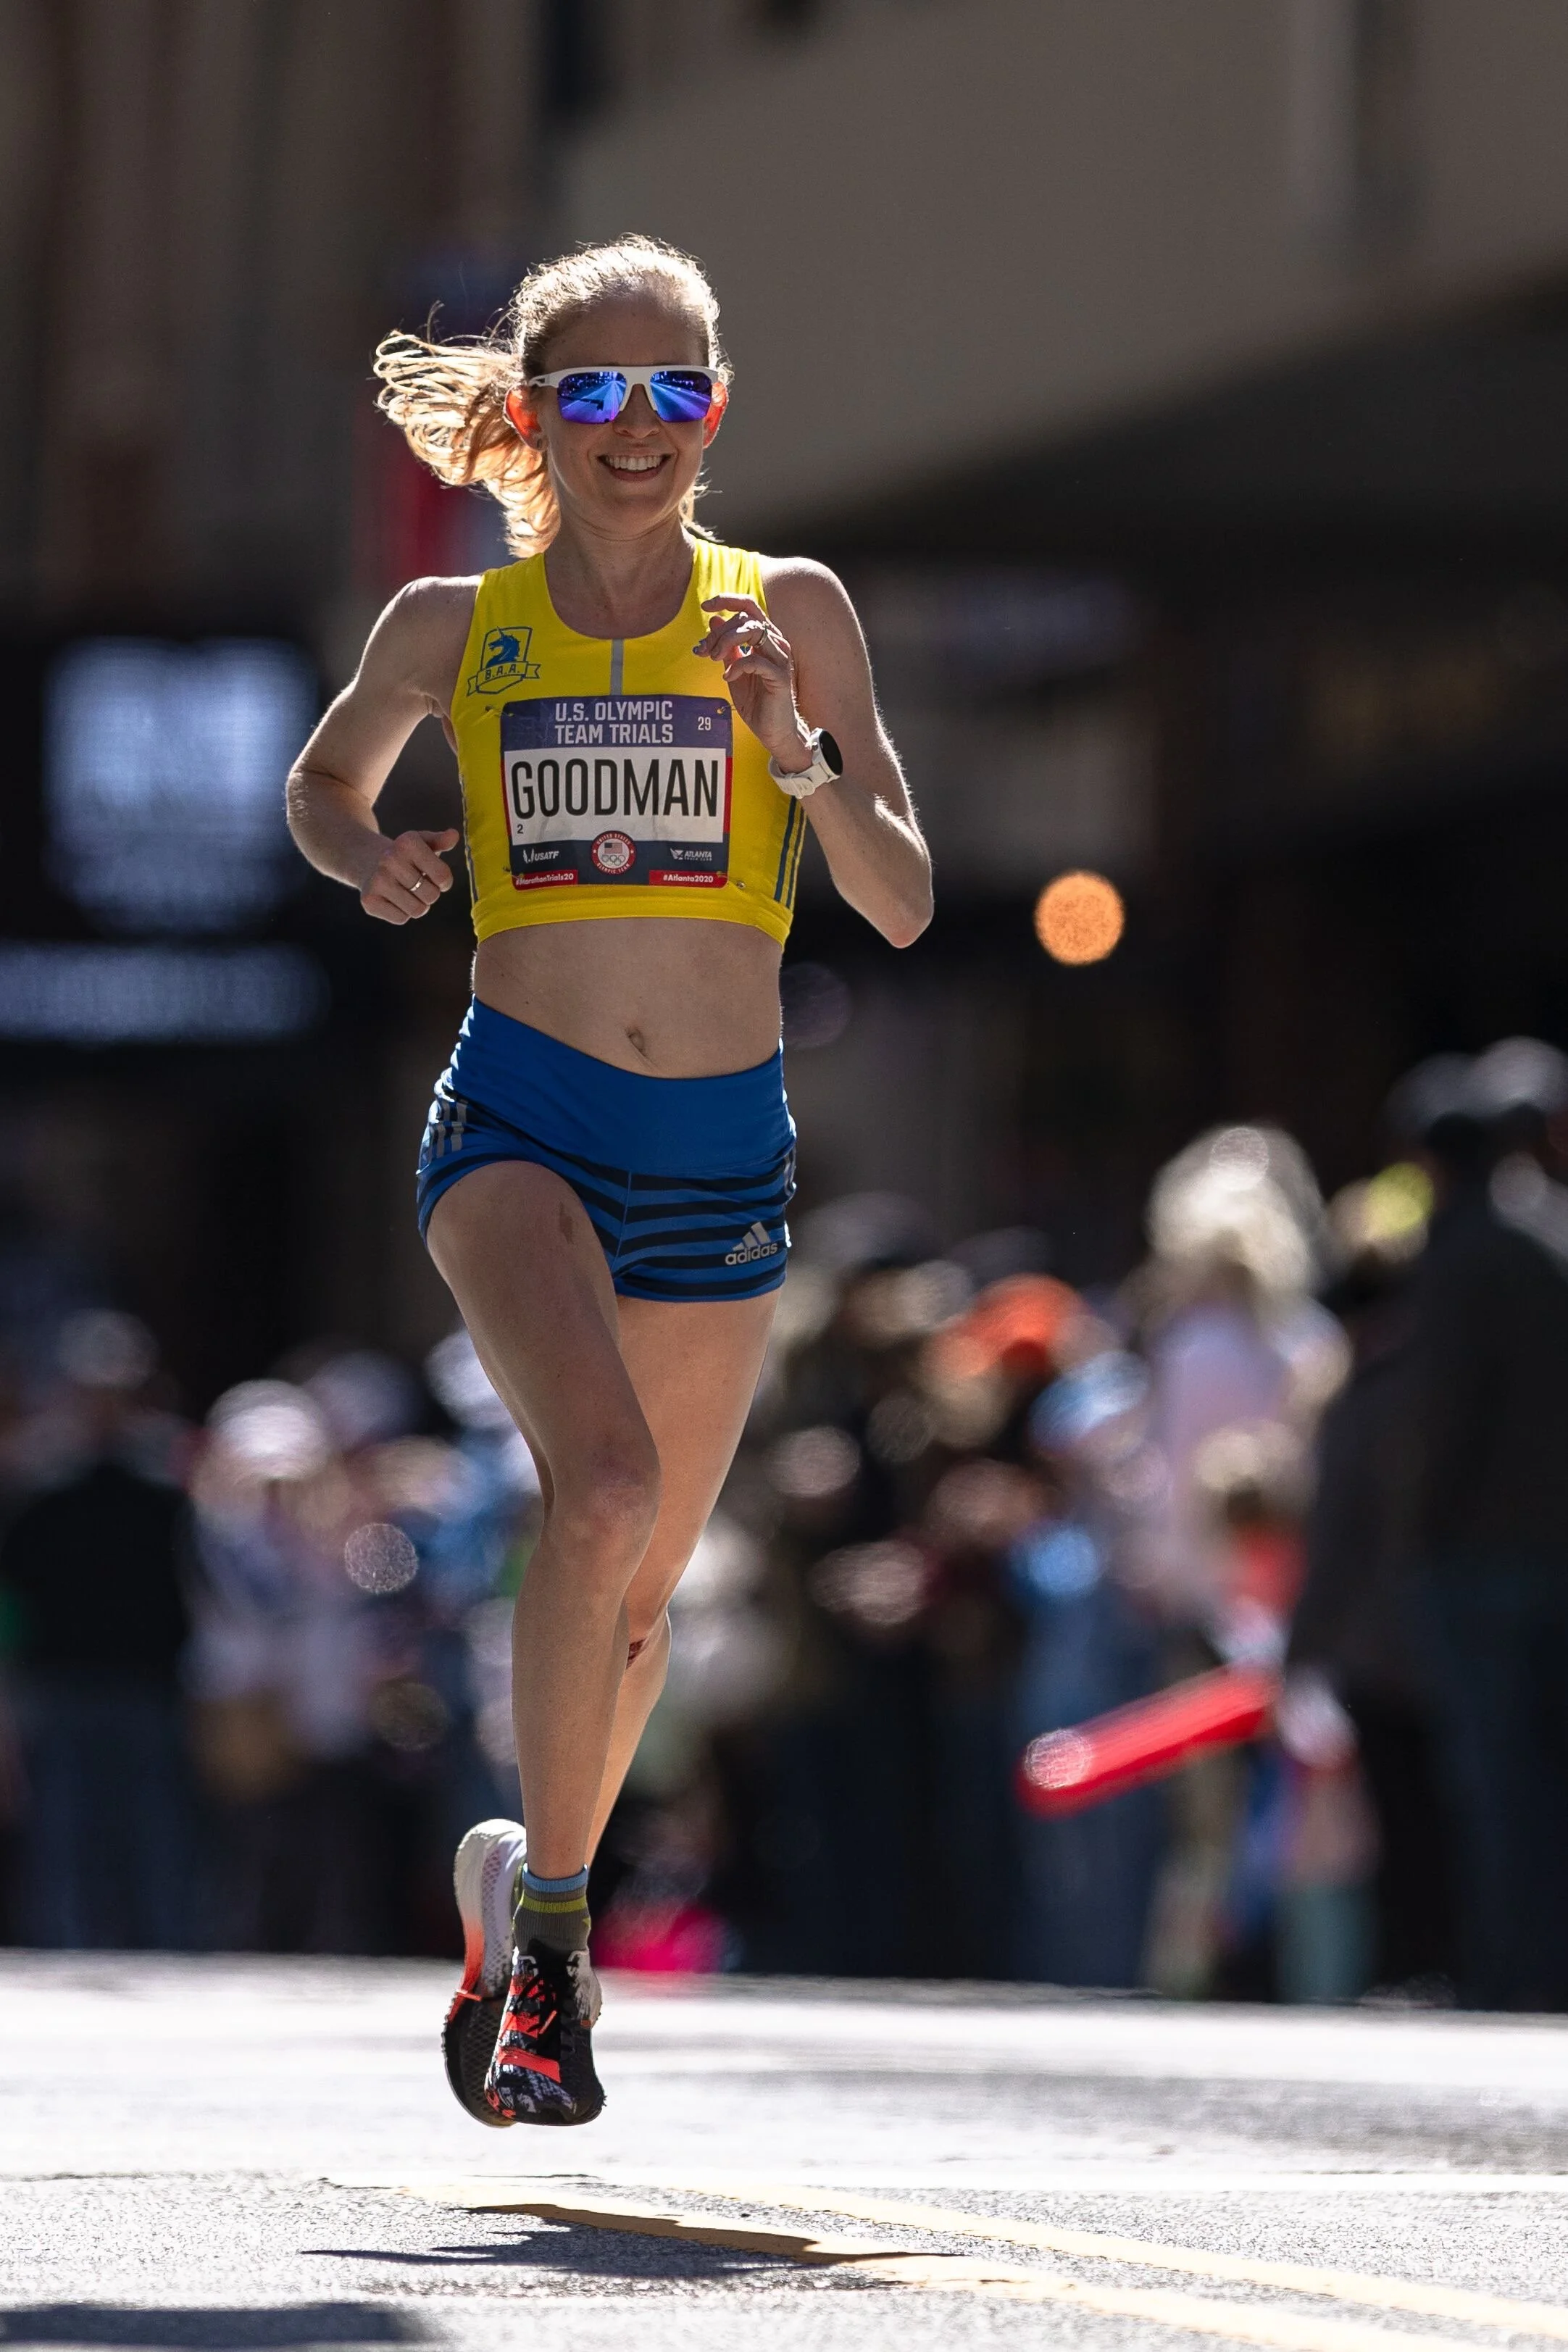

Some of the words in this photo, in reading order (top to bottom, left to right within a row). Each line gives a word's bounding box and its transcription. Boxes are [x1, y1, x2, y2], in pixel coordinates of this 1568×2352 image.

[555, 703, 589, 722] U.S.
[595, 701, 673, 721] OLYMPIC
[698, 717, 712, 731] 29
[555, 724, 603, 744] TEAM
[609, 723, 673, 743] TRIALS
[511, 758, 718, 820] GOODMAN
[517, 824, 524, 834] 2
[535, 851, 559, 861] USATF
[663, 874, 714, 883] #Atlanta2020
[725, 1243, 778, 1266] adidas
